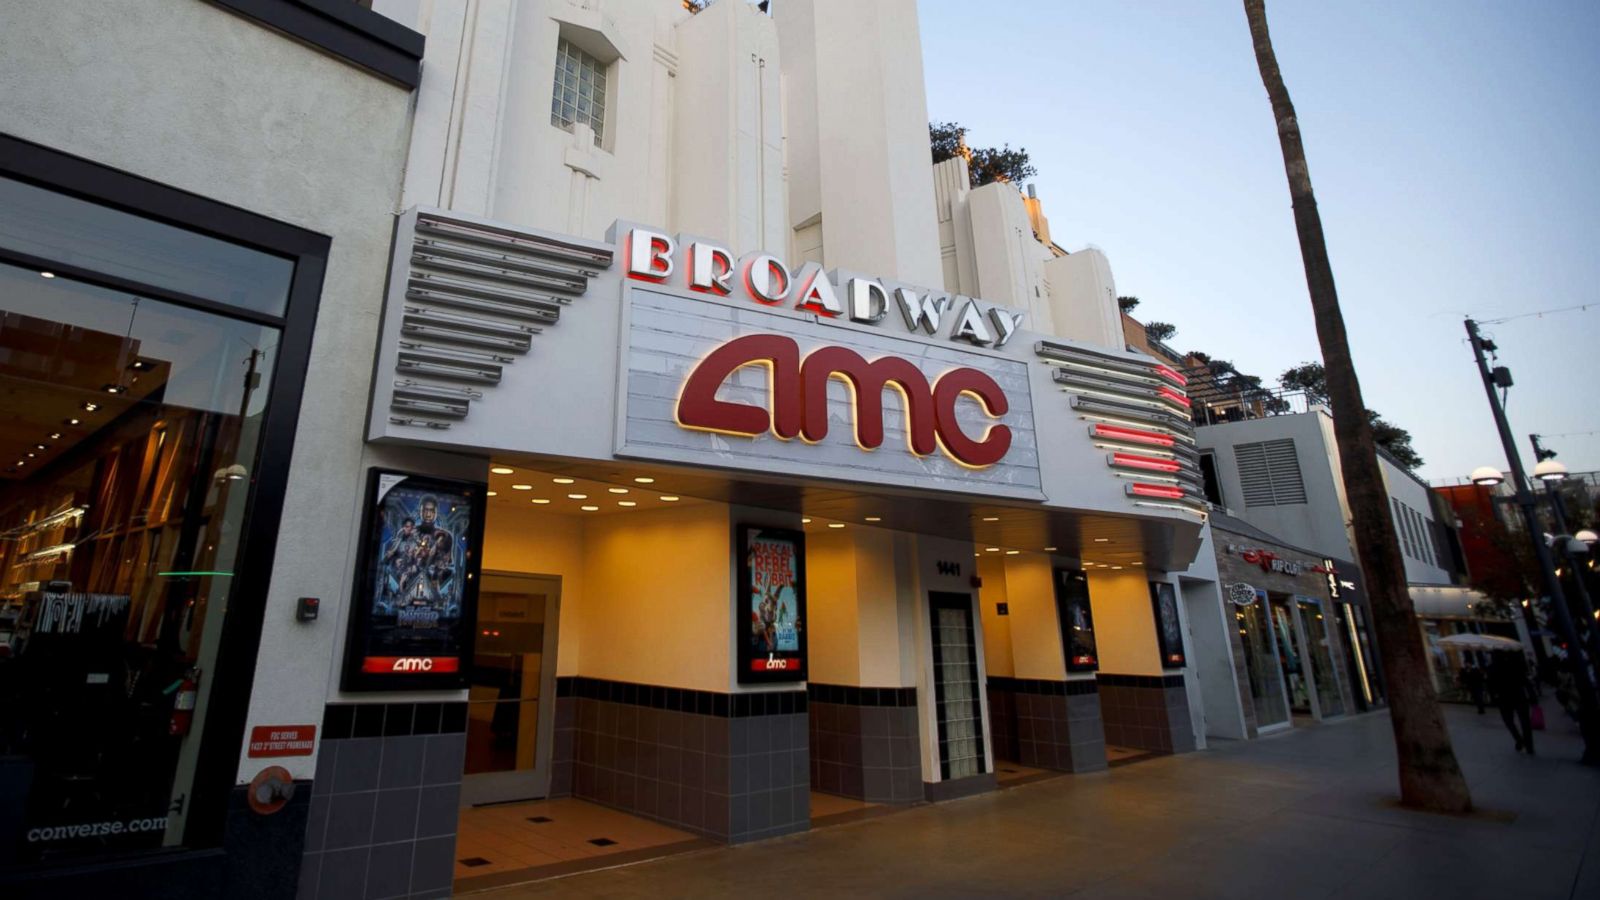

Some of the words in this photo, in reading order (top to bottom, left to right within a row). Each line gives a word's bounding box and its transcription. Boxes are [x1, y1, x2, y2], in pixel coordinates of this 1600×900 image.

[627, 227, 1024, 348] BROADWAY
[755, 555, 790, 572] REBEL
[27, 815, 169, 843] converse.com
